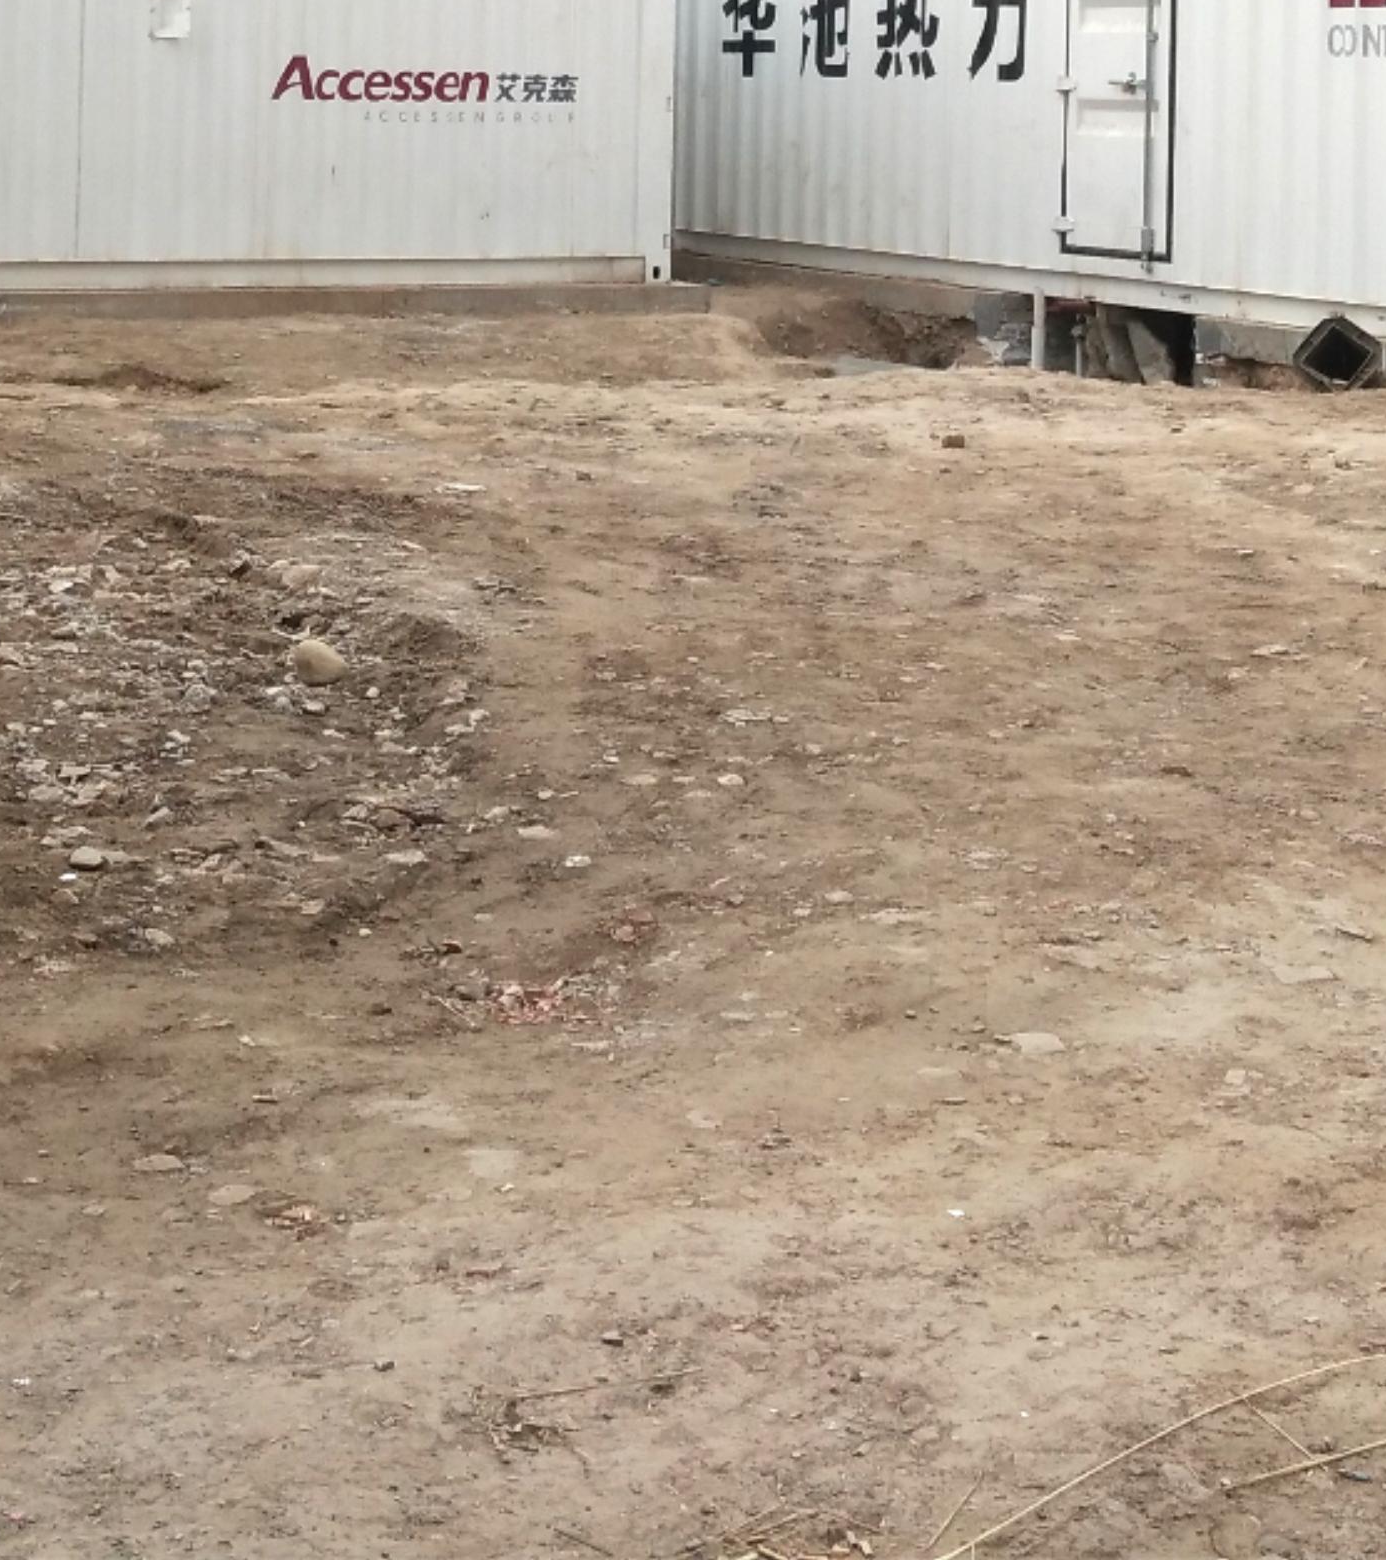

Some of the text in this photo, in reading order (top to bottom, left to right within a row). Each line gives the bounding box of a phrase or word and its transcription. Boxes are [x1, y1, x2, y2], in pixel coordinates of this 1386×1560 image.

[271, 55, 579, 103] Accessen 艾克森
